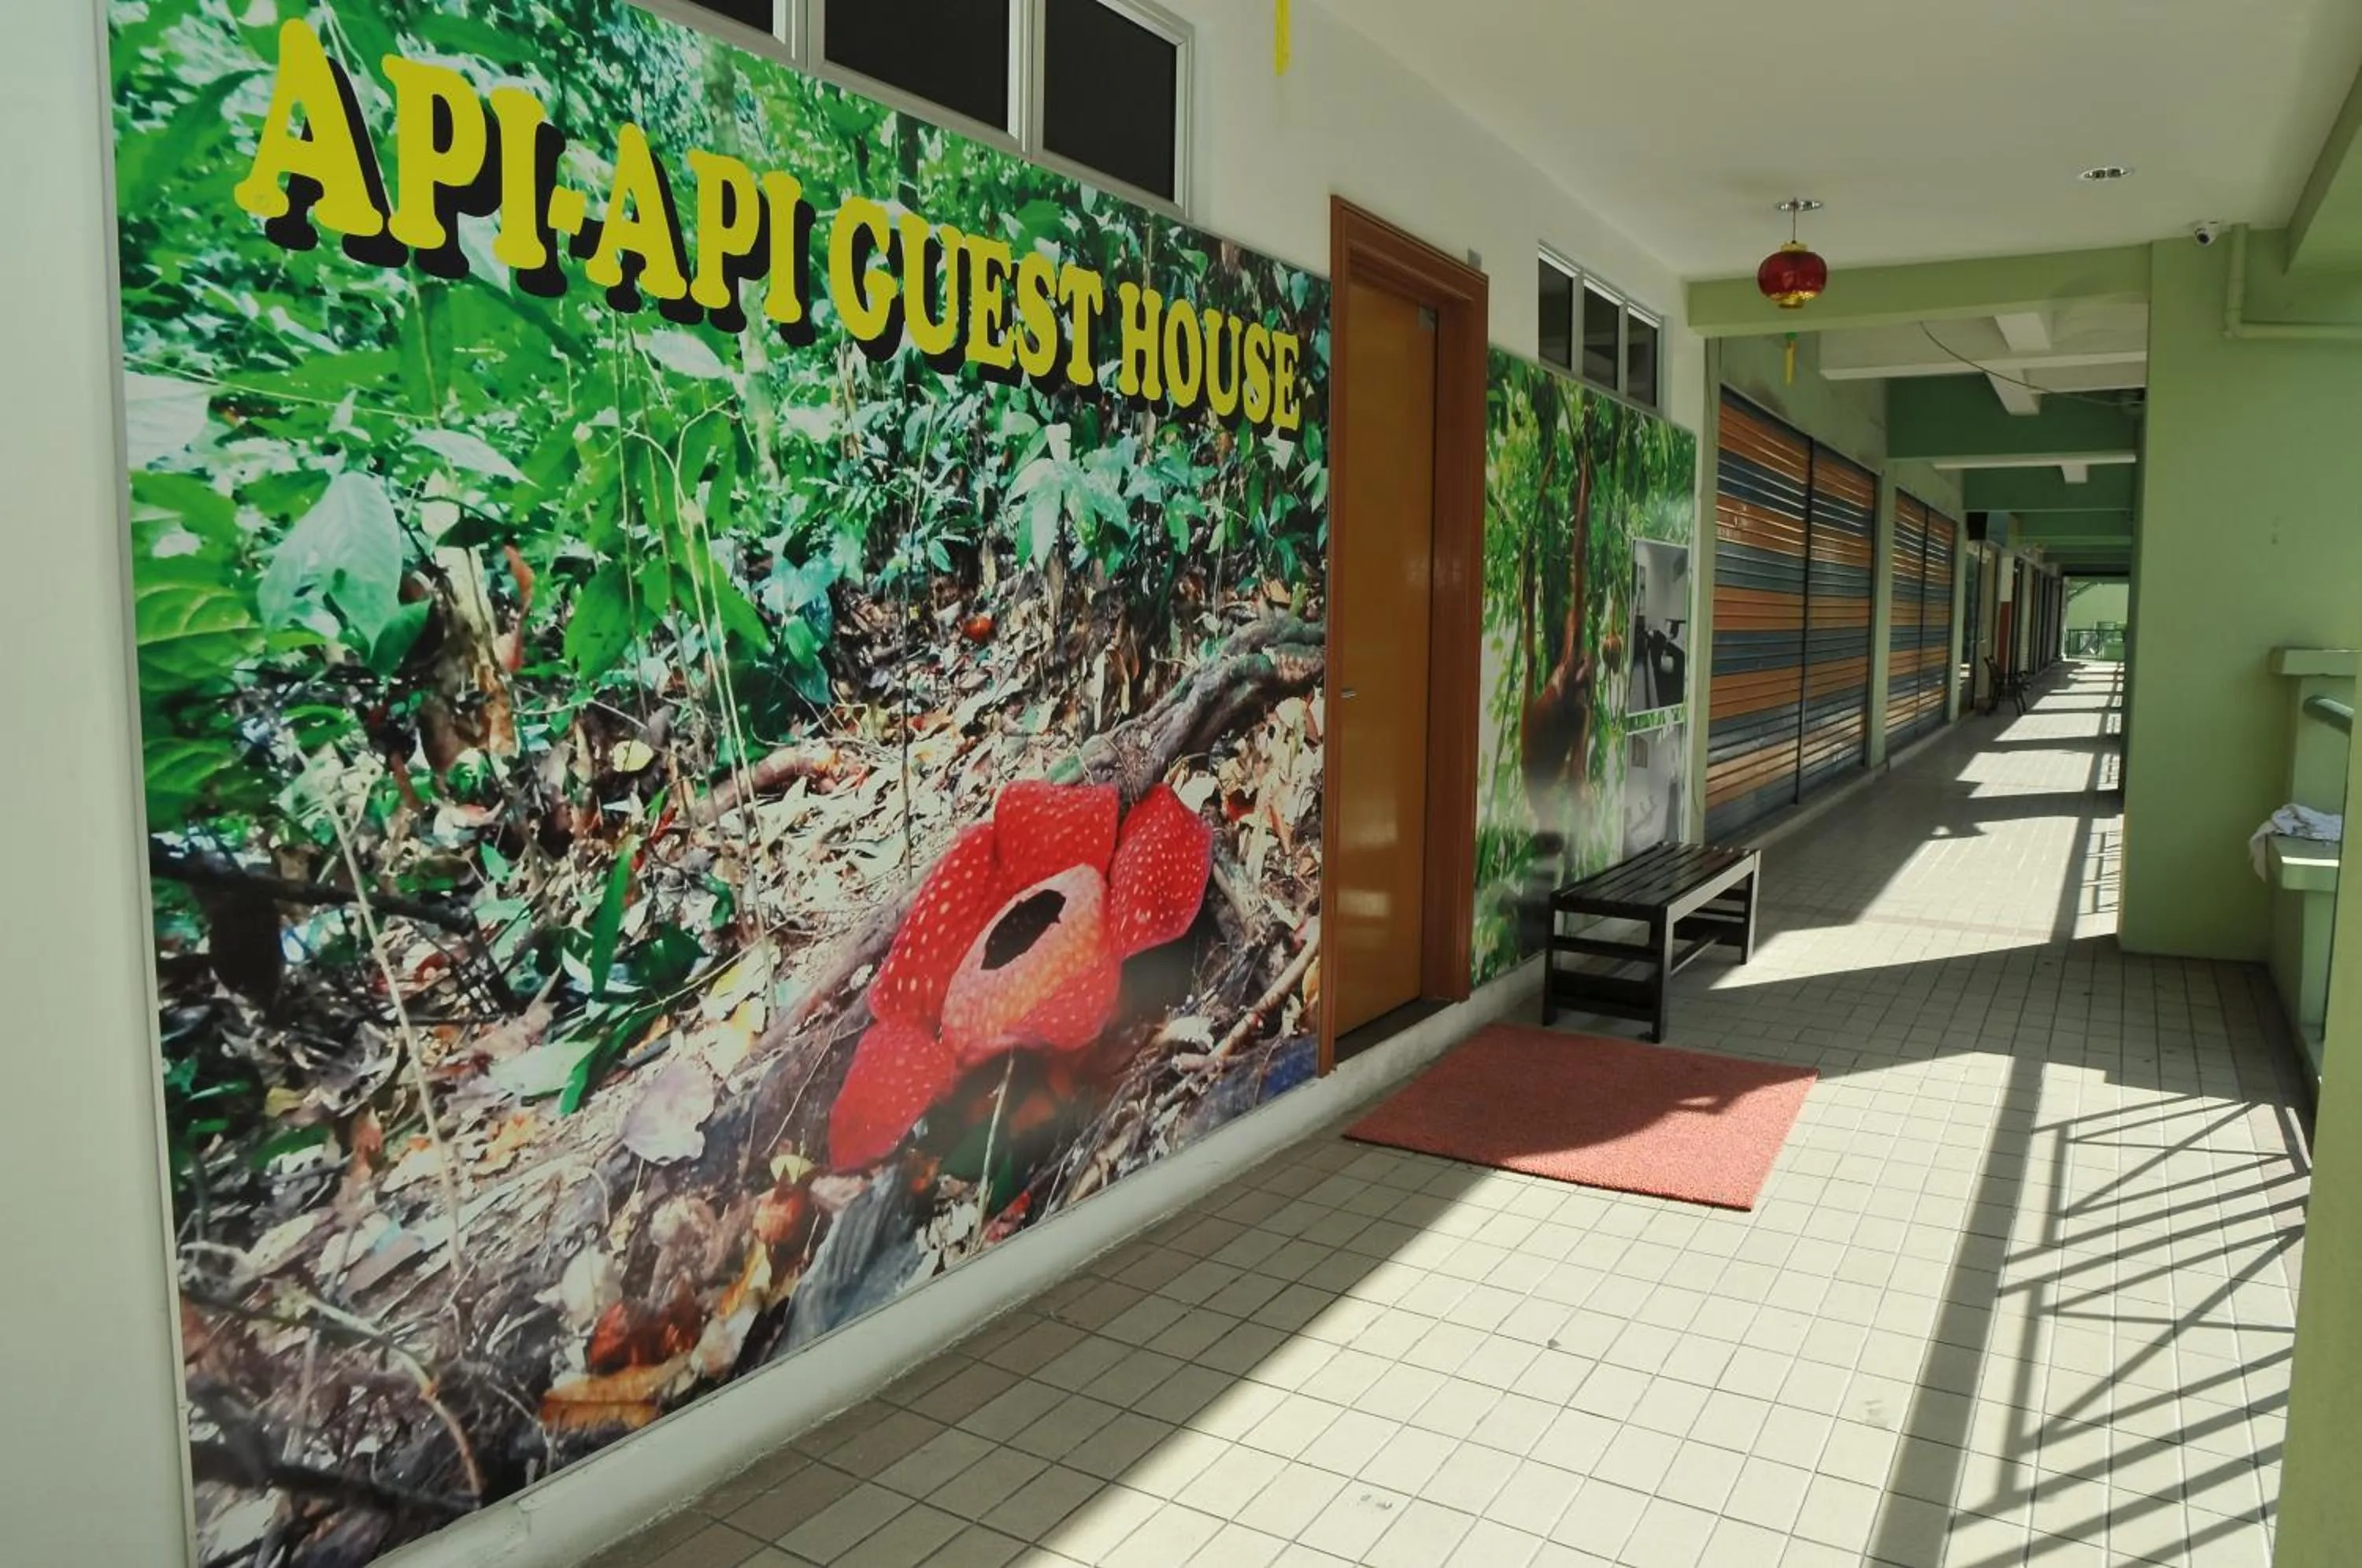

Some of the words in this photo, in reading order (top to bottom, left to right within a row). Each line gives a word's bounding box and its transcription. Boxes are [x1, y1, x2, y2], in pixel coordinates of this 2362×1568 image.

[234, 17, 802, 324] API-API
[828, 195, 1104, 387] GUEST
[1116, 280, 1301, 431] HOUSE
